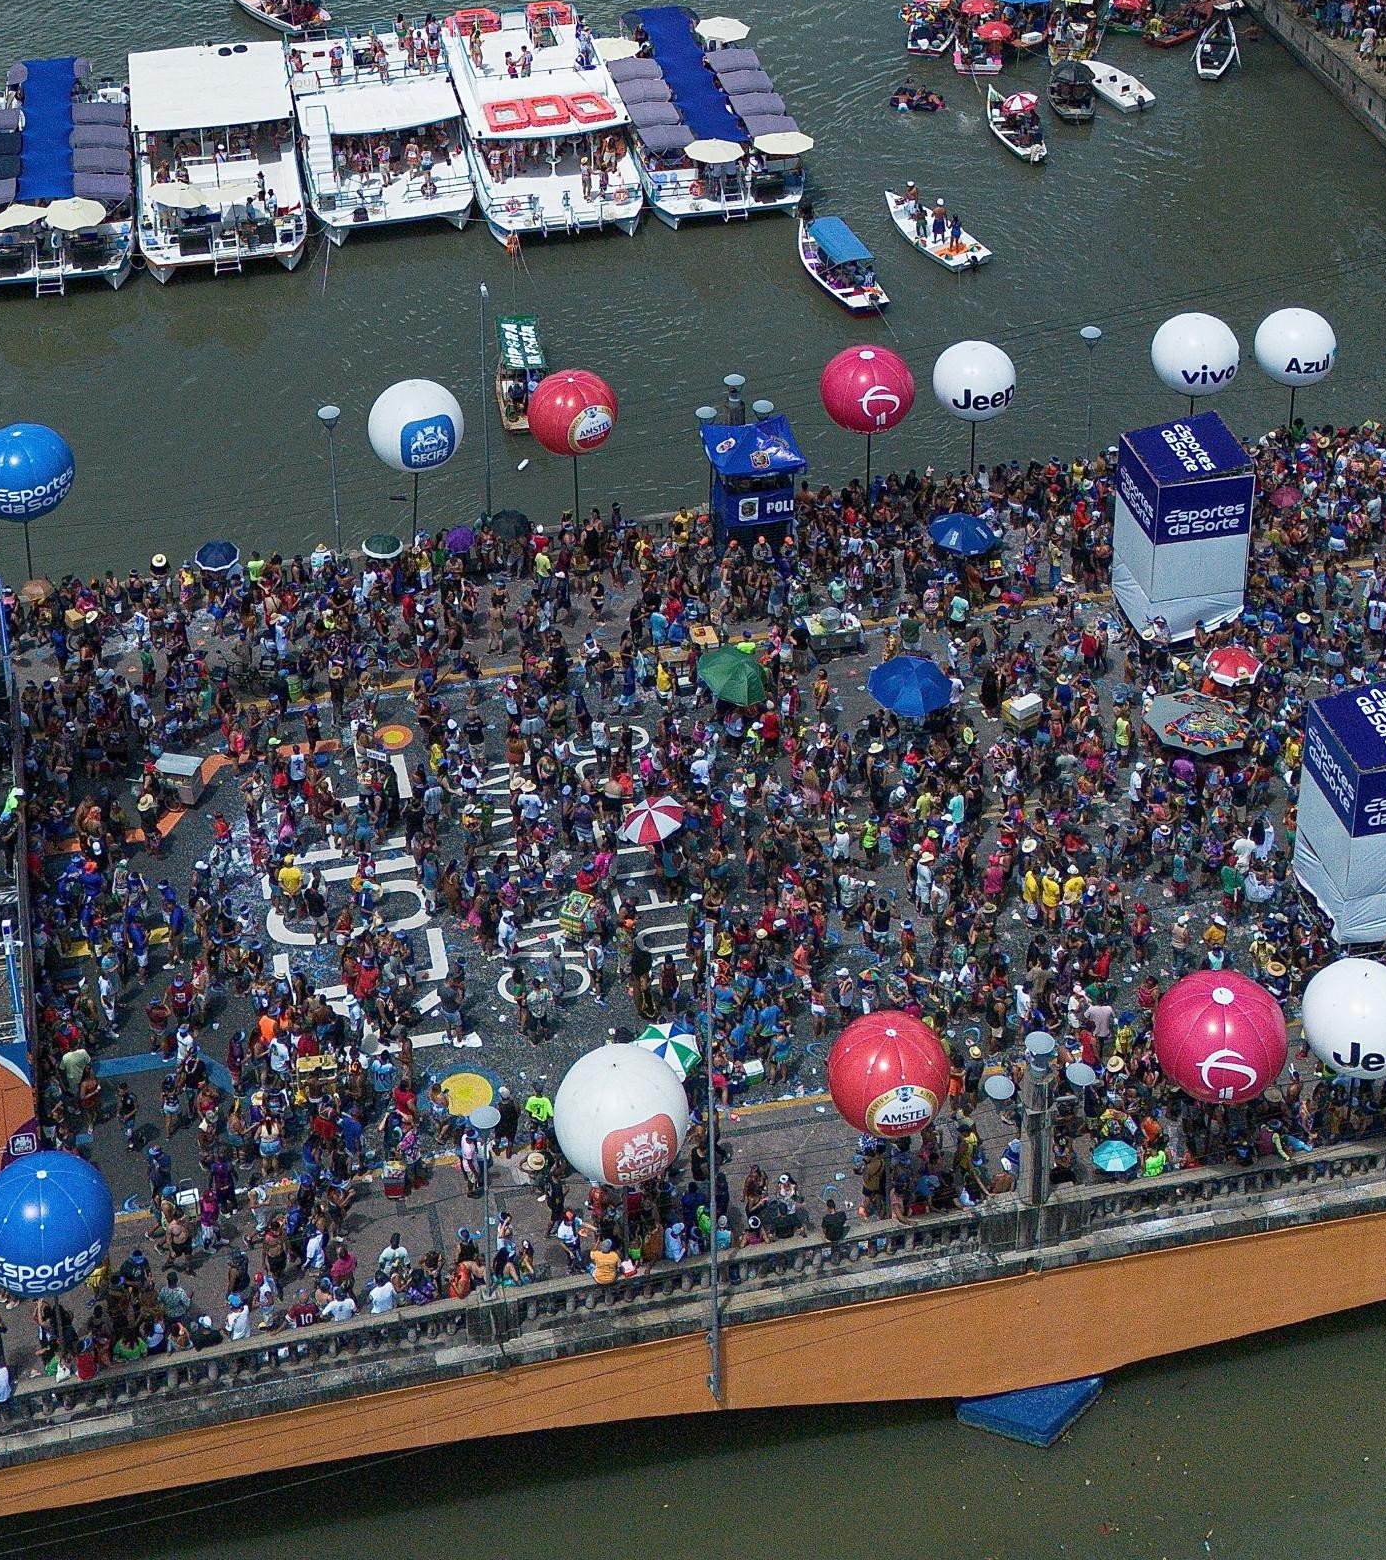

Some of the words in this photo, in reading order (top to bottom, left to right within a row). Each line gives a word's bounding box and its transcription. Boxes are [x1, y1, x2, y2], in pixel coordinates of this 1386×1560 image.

[1182, 364, 1238, 385] vivo
[1285, 352, 1333, 376] Azul
[953, 385, 1015, 415] Jeep
[579, 422, 610, 438] AMSTEL
[1168, 442, 1199, 473] Sorte
[1174, 424, 1217, 472] Esportes
[0, 501, 27, 514] da
[28, 486, 71, 510] Sorte
[1164, 503, 1245, 525] Esportes
[1168, 519, 1190, 535] da
[1191, 514, 1240, 534] Sorte
[1354, 696, 1377, 715] da
[881, 1109, 929, 1124] AMSTEL
[618, 1158, 669, 1183] RECIFE
